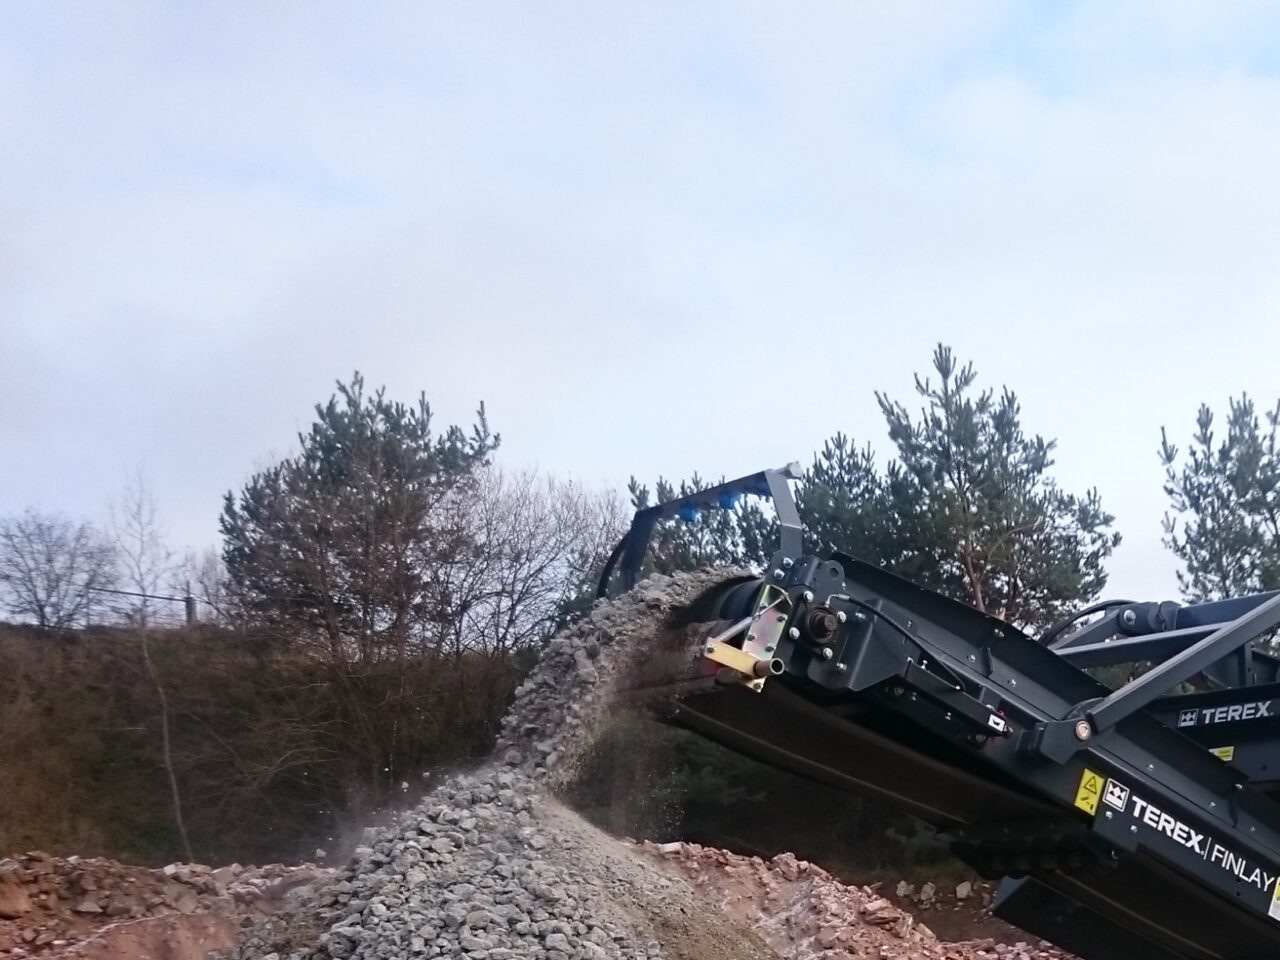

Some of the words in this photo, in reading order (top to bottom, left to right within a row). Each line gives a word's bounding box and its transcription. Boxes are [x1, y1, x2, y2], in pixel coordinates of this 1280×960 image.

[1202, 701, 1272, 724] TEREX
[1131, 795, 1204, 856] TEREX
[1211, 844, 1275, 892] FINLAY
